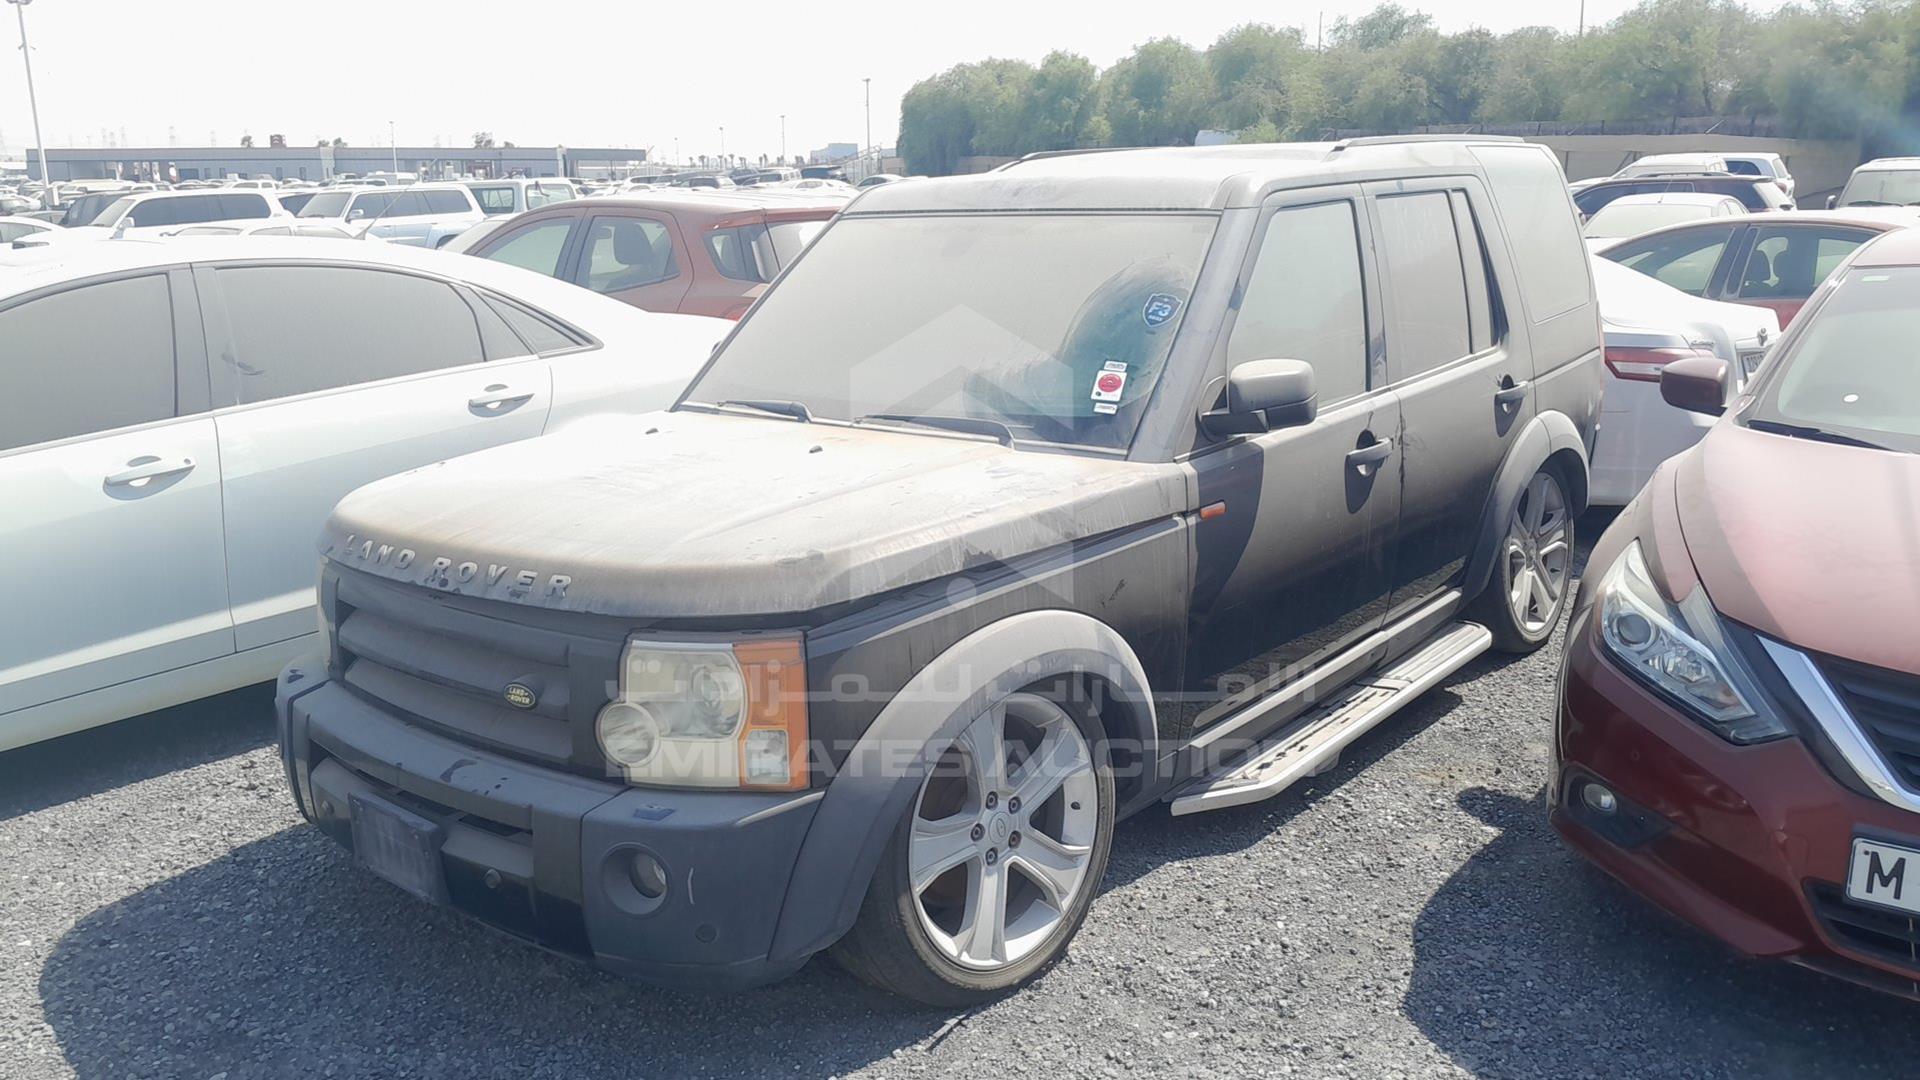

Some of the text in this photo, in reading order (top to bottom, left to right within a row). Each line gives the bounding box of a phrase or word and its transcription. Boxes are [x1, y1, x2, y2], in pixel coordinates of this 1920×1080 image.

[344, 534, 572, 598] LAND ROVER
[1866, 851, 1906, 900] M
